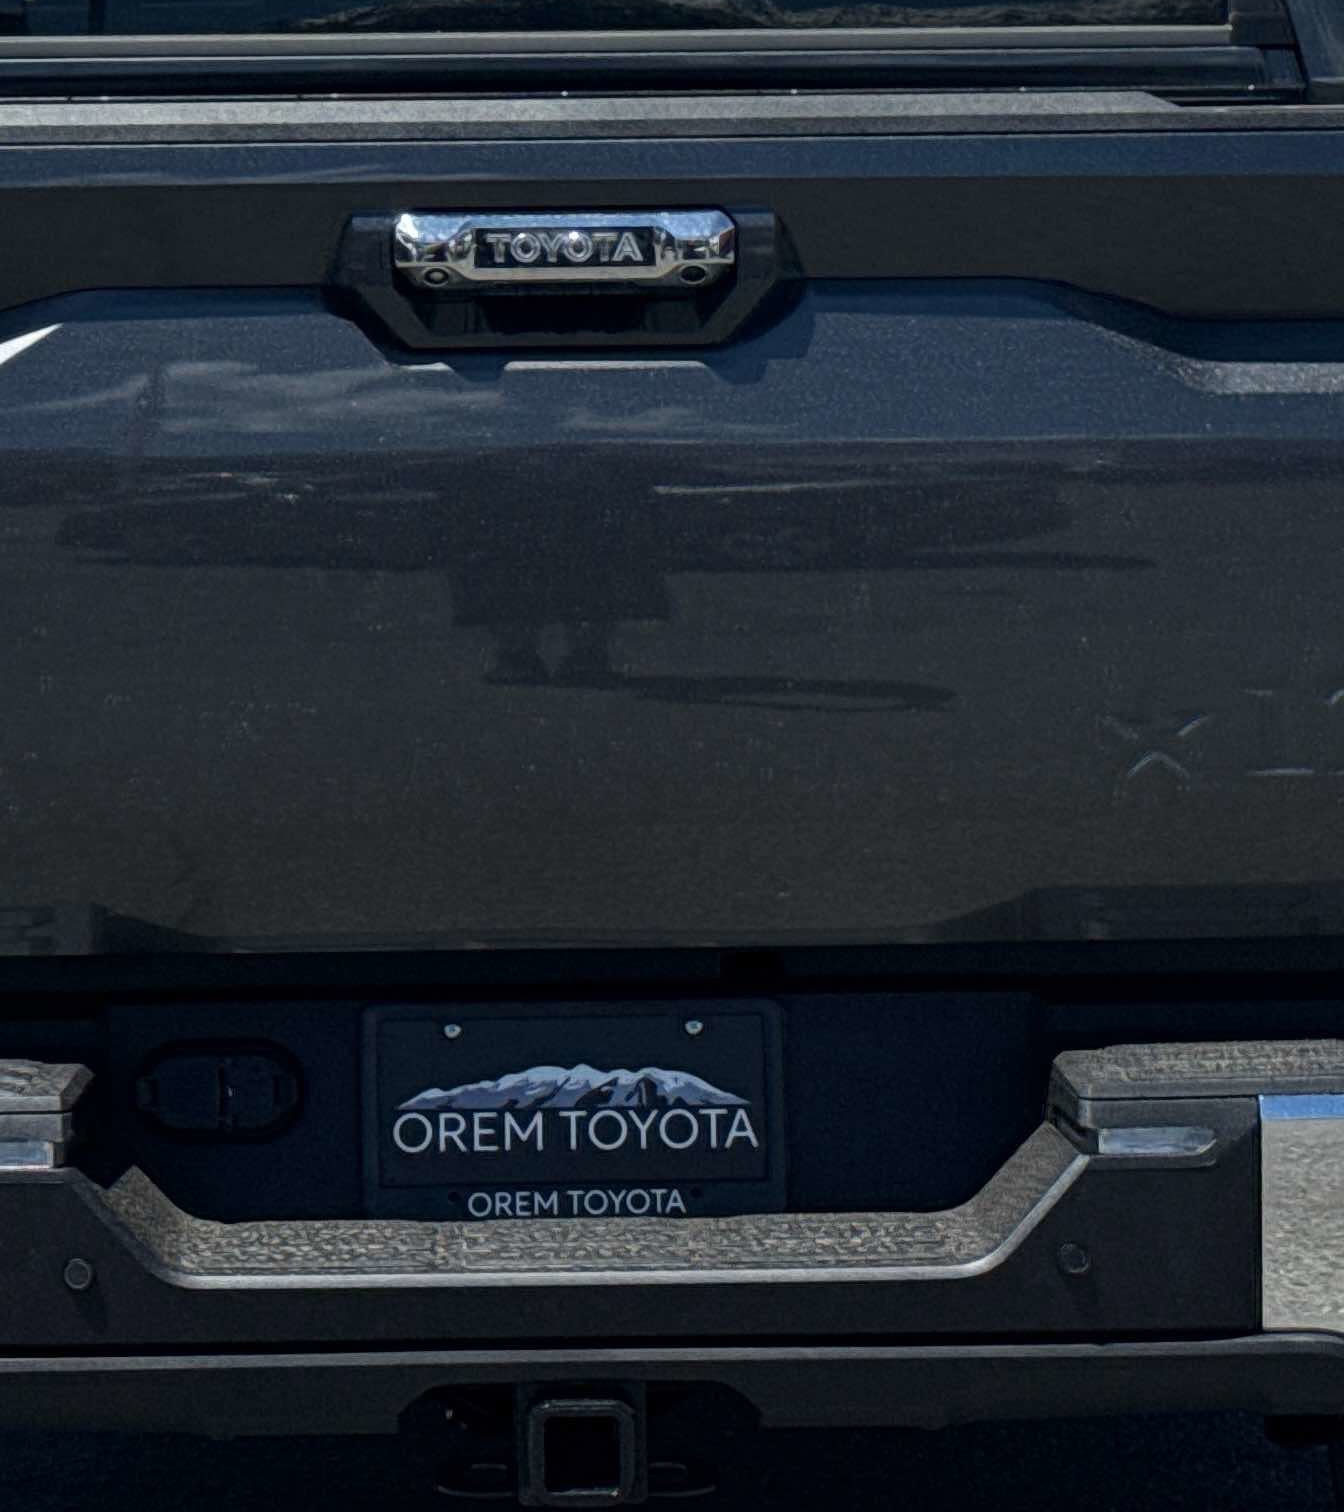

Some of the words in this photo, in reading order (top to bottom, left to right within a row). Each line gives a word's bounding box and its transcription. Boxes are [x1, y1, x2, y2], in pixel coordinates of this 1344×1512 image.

[486, 230, 645, 264] TOYOTA
[392, 1110, 544, 1153] OREM
[559, 1108, 759, 1151] TOYOTA
[467, 1190, 560, 1218] OREM
[566, 1188, 687, 1215] TOYOTA
